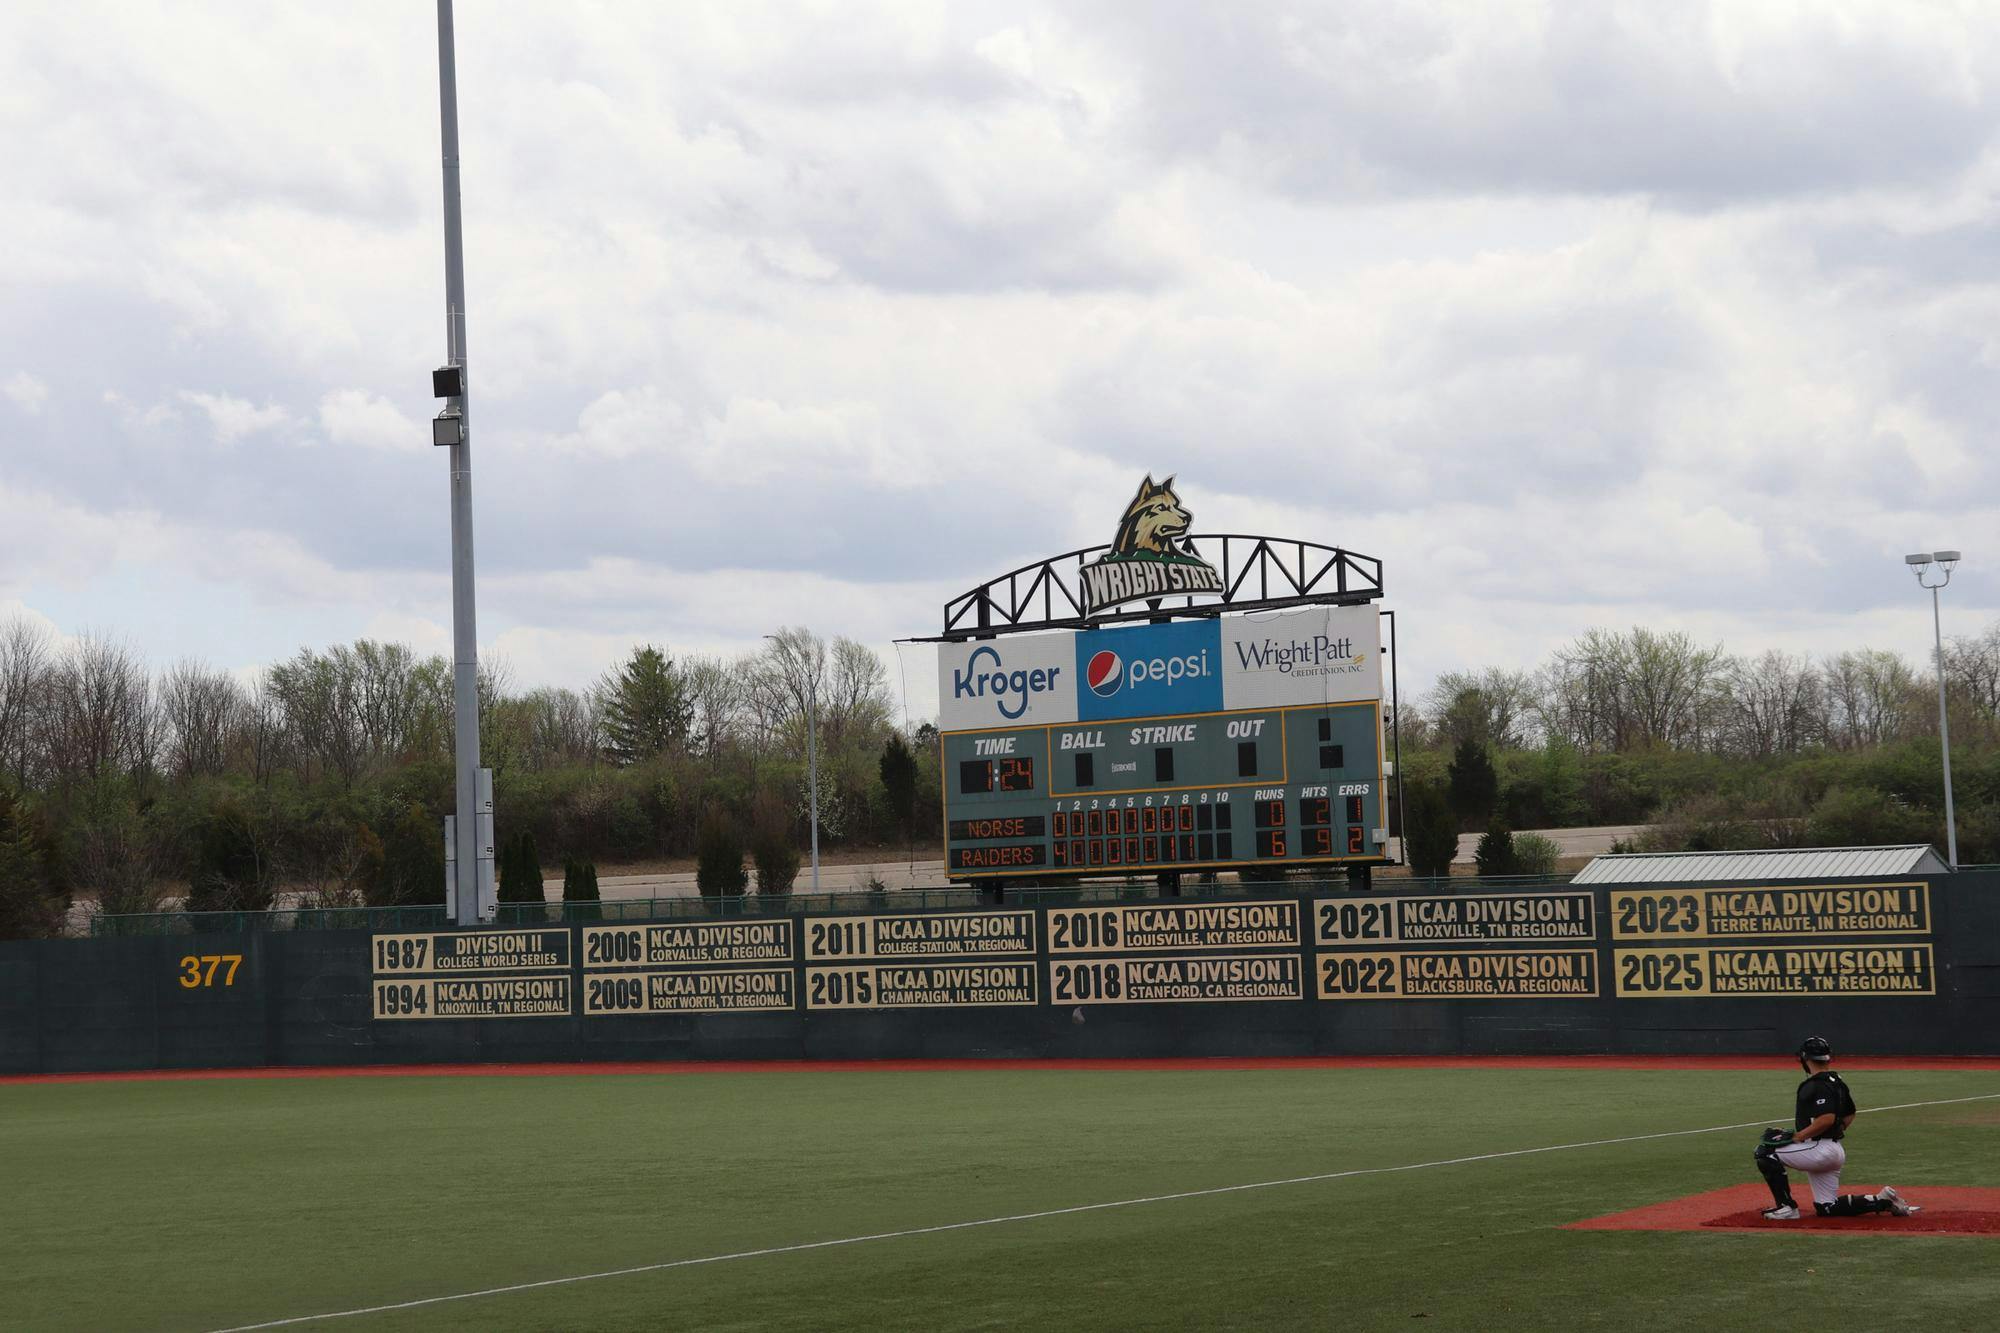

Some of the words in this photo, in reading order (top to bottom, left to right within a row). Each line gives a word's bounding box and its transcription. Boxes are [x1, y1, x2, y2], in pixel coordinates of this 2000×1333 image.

[1085, 561, 1168, 608] WRIGHT
[1169, 563, 1223, 590] STATE
[1235, 635, 1352, 673] Wright-Patt
[1130, 649, 1206, 689] pepsi
[1291, 668, 1318, 678] CREDIT
[955, 646, 1060, 719] Kroger
[975, 737, 1016, 755] TIME
[1061, 731, 1106, 750] BALL
[1129, 724, 1197, 744] STRIKE
[1227, 720, 1265, 738] OUT
[987, 759, 1033, 791] 1:24
[1056, 802, 1061, 811] 1
[1074, 801, 1080, 810] 2
[1092, 800, 1098, 809] 3
[1109, 799, 1116, 808] 4
[1127, 798, 1134, 807] 5
[1145, 797, 1152, 806] 6
[1164, 796, 1170, 805] 7
[1182, 794, 1189, 804] 8
[1200, 793, 1207, 803] 9
[1216, 792, 1228, 802] 10
[1254, 789, 1284, 800] RUNS
[1302, 787, 1327, 797] HITS
[1338, 784, 1369, 796] ERRS
[968, 819, 1025, 837] NORSE
[1054, 813, 1065, 836] 0
[1072, 813, 1083, 835] 0
[1090, 812, 1100, 835] 0
[1108, 810, 1119, 834] 0
[1126, 809, 1137, 833] 0
[1144, 808, 1155, 832] 0
[1162, 808, 1173, 831] 0
[1180, 807, 1192, 831] 0
[1271, 802, 1284, 826] 0
[1316, 800, 1328, 823] 2
[962, 847, 1034, 866] RAIDERS
[1055, 843, 1066, 864] 4
[1072, 841, 1084, 864] 0
[1090, 840, 1102, 864] 0
[1108, 839, 1120, 863] 0
[1126, 838, 1138, 862] 0
[1144, 838, 1156, 861] 0
[1170, 837, 1175, 860] 1
[1189, 836, 1193, 859] 1
[1272, 832, 1285, 856] 6
[1317, 829, 1330, 853] 9
[1350, 828, 1362, 852] 2
[1404, 901, 1458, 924] NCAA
[1467, 899, 1570, 922] DIVISION
[1579, 899, 1584, 920] I
[1619, 895, 1699, 933] 2023
[1711, 893, 1776, 917] NCAA
[1783, 890, 1900, 915] DIVISION
[1911, 889, 1917, 912] I
[878, 920, 926, 940] NCAA
[931, 917, 1015, 939] DIVISION
[1022, 917, 1026, 935] I
[1053, 911, 1118, 948] 2016
[1126, 911, 1180, 932] NCAA
[1185, 907, 1278, 930] DIVISION
[1285, 907, 1291, 926] I
[1320, 903, 1392, 940] 2021
[1404, 924, 1485, 939] KNOXVILLE,
[1488, 924, 1507, 937] TN
[1511, 923, 1587, 936] REGIONAL
[1712, 918, 1758, 932] TERRE
[1762, 917, 1816, 932] HAUTE,
[1818, 916, 1834, 930] IN
[1838, 914, 1918, 929] REGIONAL
[456, 935, 526, 955] DIVISION
[531, 935, 542, 952] II
[588, 931, 641, 963] 2006
[651, 929, 695, 947] NCAA
[699, 926, 773, 945] DIVISION
[780, 926, 784, 942] I
[812, 921, 866, 955] 2011
[878, 941, 919, 953] COLLEGE
[920, 940, 963, 953] STATION,
[964, 940, 977, 951] TX
[978, 939, 1027, 951] REGIONAL
[1127, 933, 1203, 946] LOUISVILLE,
[1207, 932, 1224, 944] KY
[1227, 929, 1294, 943] REGIONAL
[377, 939, 428, 969] 1987
[437, 955, 479, 969] COLLEGE
[482, 955, 517, 967] WORLD
[521, 953, 557, 965] SERIES
[651, 948, 711, 961] CORVALLIS,
[714, 948, 729, 959] OR
[732, 946, 786, 958] REGIONAL
[1715, 953, 1780, 976] NCAA
[1786, 950, 1903, 974] DIVISION
[1914, 950, 1921, 973] I
[180, 954, 242, 988] 377
[881, 971, 928, 989] NCAA
[933, 968, 1017, 988] DIVISION
[1023, 968, 1028, 986] I
[1129, 963, 1182, 984] NCAA
[1187, 960, 1281, 982] DIVISION
[1288, 960, 1293, 980] I
[1323, 958, 1395, 993] 2022
[1406, 957, 1461, 978] NCAA
[1469, 956, 1573, 977] DIVISION
[1581, 956, 1587, 977] I
[1622, 954, 1703, 991] 2025
[438, 983, 479, 1001] NCAA
[482, 981, 553, 1000] DIVISION
[559, 981, 563, 998] I
[589, 978, 642, 1010] 2009
[652, 977, 697, 995] NCAA
[701, 975, 776, 993] DIVISION
[782, 974, 786, 992] I
[811, 971, 871, 1005] 2015
[1056, 964, 1120, 1000] 2018
[1130, 985, 1203, 999] STANFORD,
[1206, 985, 1224, 997] CA
[1227, 983, 1296, 996] REGIONAL
[1406, 980, 1498, 994] BLACKSBURG,
[1498, 980, 1515, 992] VA
[1520, 979, 1588, 992] REGIONAL
[1716, 977, 1808, 992] NASHVILLE,
[1813, 976, 1833, 989] TN
[1839, 976, 1922, 989] REGIONAL
[378, 985, 427, 1015] 1994
[438, 1002, 496, 1015] KNOXVILLE,
[498, 1002, 510, 1013] TN
[514, 1000, 565, 1012] REGIONAL
[653, 997, 678, 1008] FORT
[679, 996, 719, 1008] WORTH,
[721, 996, 735, 1007] TX
[737, 994, 787, 1006] REGIONAL
[881, 991, 953, 1003] CHAMPAIGN,
[956, 991, 967, 1001] IL
[970, 989, 1030, 1001] REGIONAL
